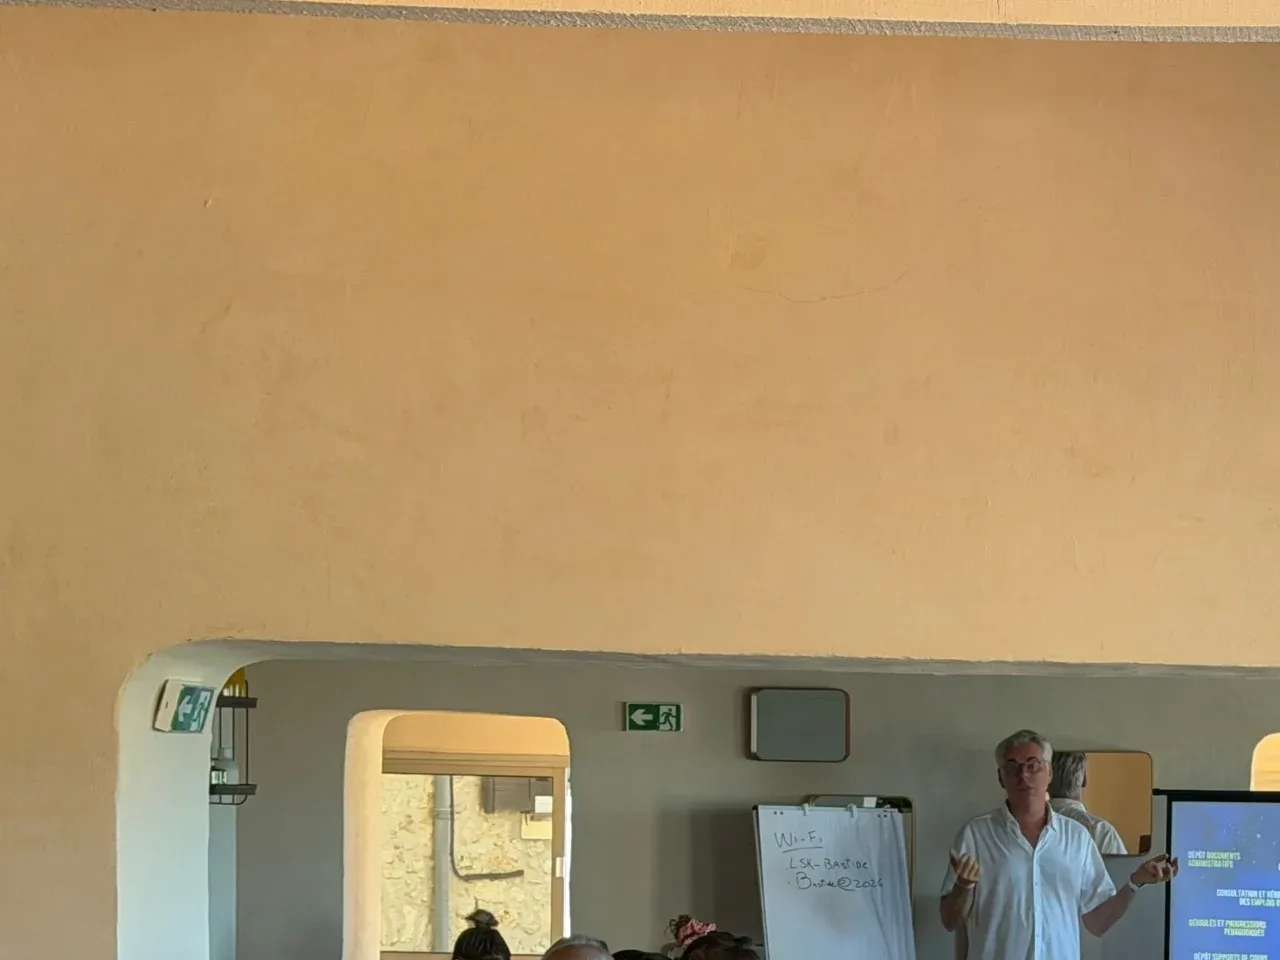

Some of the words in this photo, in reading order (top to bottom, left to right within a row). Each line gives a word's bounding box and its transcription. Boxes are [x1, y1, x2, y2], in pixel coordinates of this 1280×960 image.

[1207, 851, 1241, 860] DOCUMENTS
[1188, 859, 1233, 868] ADMINISTRATIFS
[1217, 889, 1258, 897] CONSULTATION
[1259, 890, 1266, 898] ET
[1239, 898, 1251, 906] DES
[1251, 898, 1276, 906] EMPLOIS
[1217, 919, 1225, 927] ET
[1225, 920, 1267, 929] PROGRESSIONS
